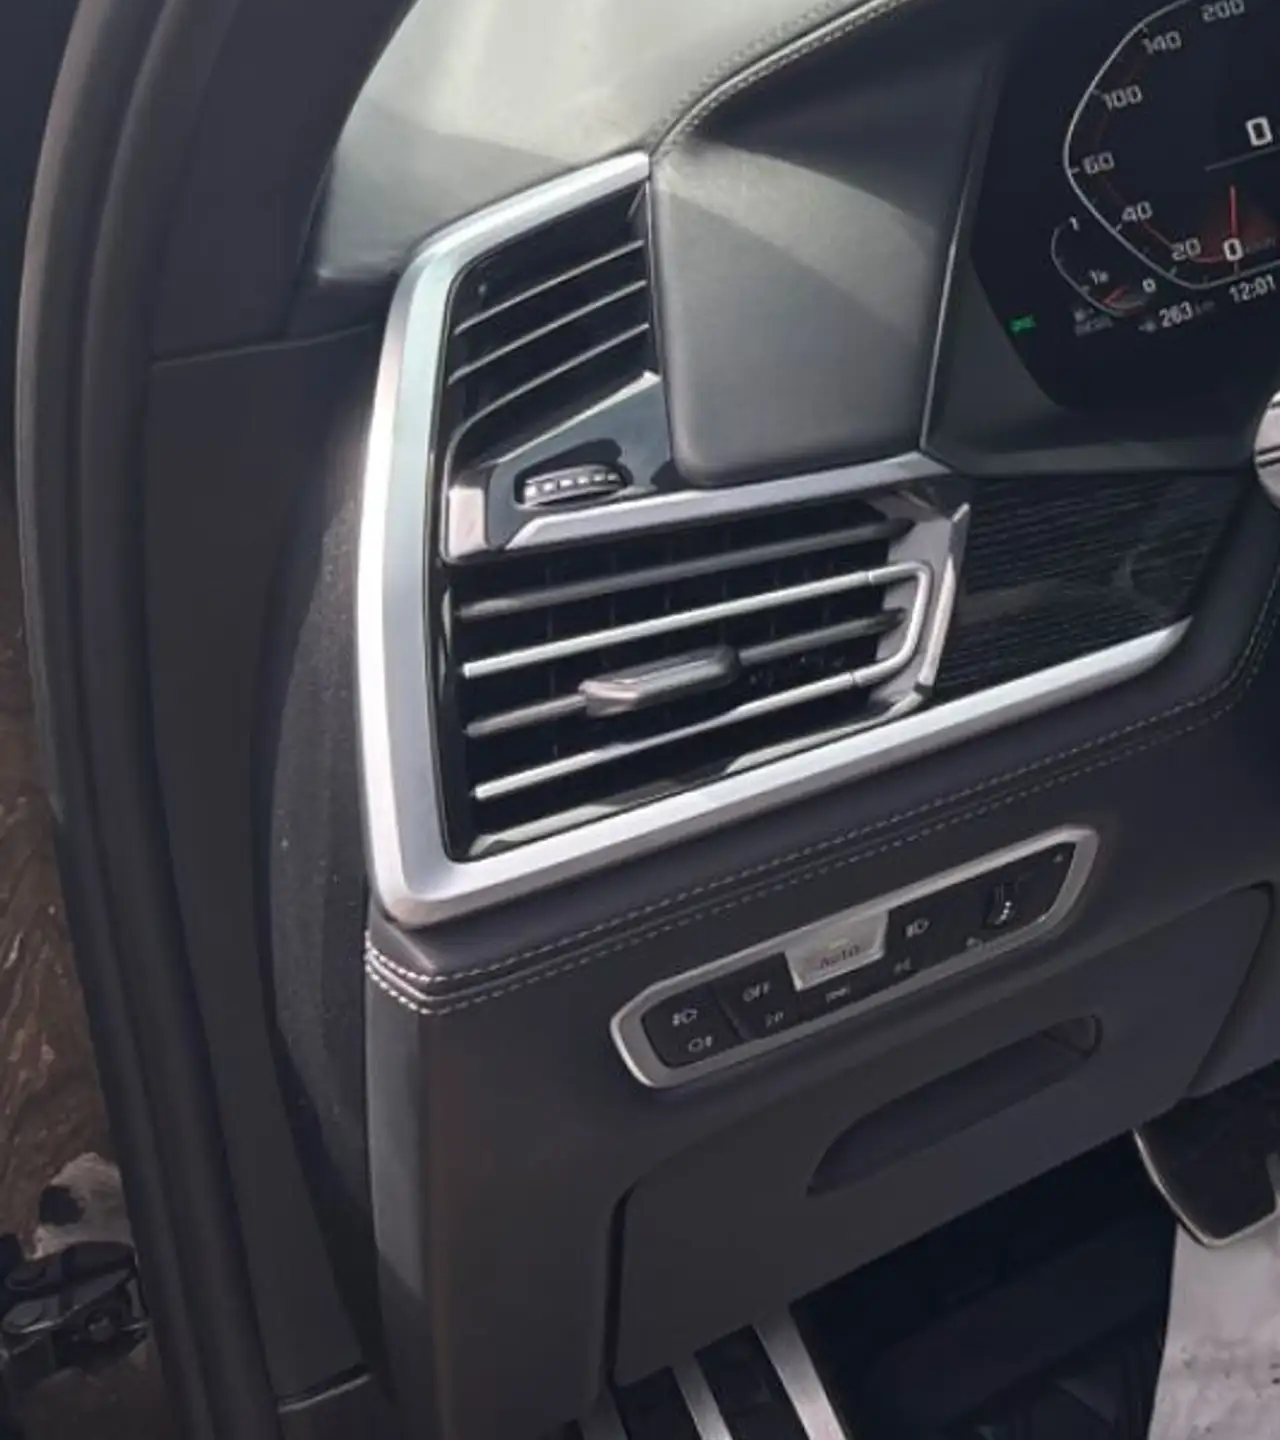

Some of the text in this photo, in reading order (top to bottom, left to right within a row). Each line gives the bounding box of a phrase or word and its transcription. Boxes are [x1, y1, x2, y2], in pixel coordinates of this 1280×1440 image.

[1141, 30, 1183, 55] 140
[1101, 84, 1144, 111] 100
[1245, 116, 1274, 147] 0
[1081, 151, 1115, 175] 60
[1121, 201, 1153, 223] 40
[1171, 238, 1202, 261] 20
[1222, 237, 1243, 262] 0
[1142, 278, 1157, 294] 0
[1229, 273, 1277, 304] 12:01
